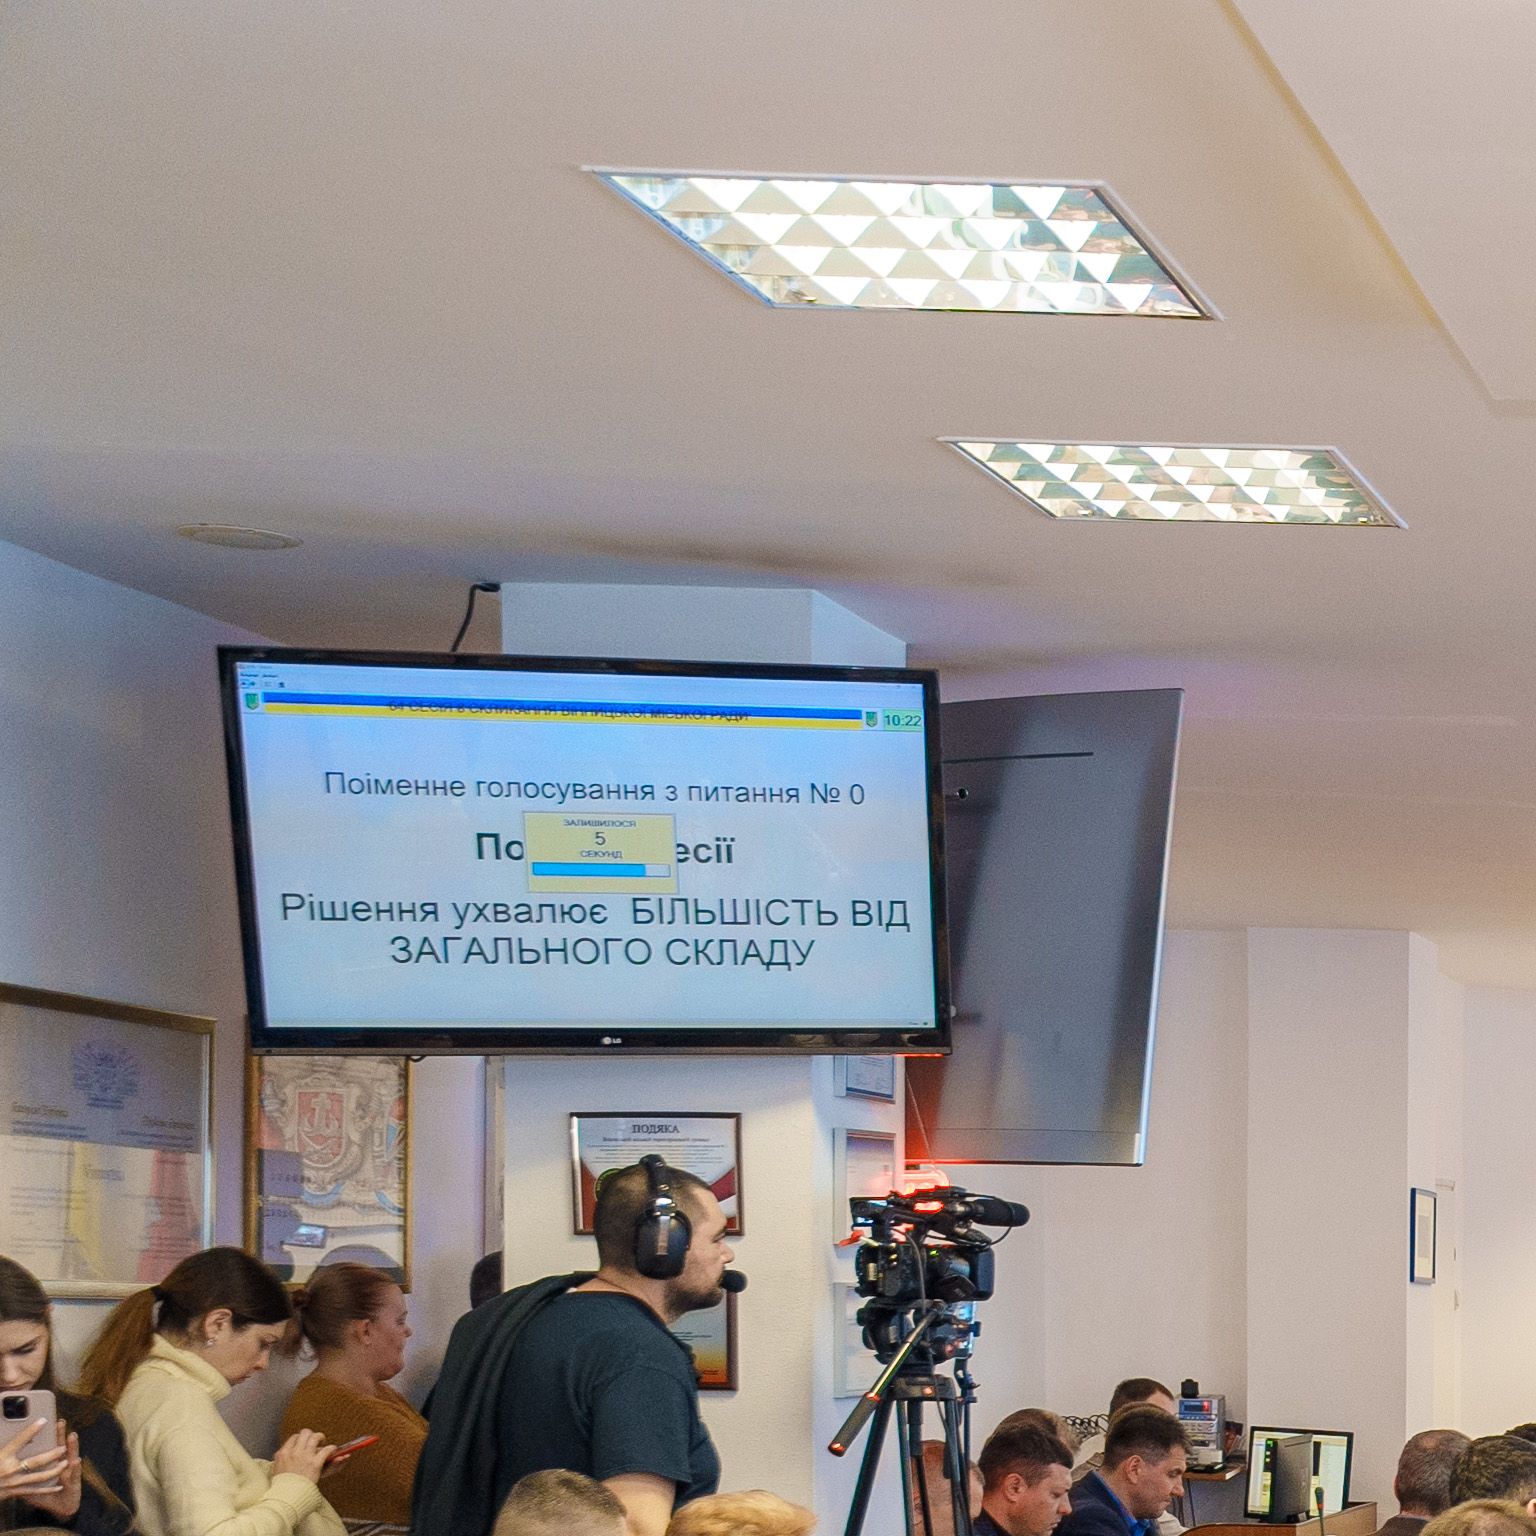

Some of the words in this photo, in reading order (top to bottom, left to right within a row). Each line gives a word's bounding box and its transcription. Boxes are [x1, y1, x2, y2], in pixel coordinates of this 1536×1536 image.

[884, 714, 922, 727] 10:22
[325, 771, 467, 798] Поіменне
[476, 779, 655, 804] голосування
[665, 784, 679, 802] з
[688, 785, 800, 804] питання
[810, 783, 841, 805] №
[849, 783, 865, 805] 0
[563, 818, 637, 828] ЗАЛИШИЛОСЯ
[595, 831, 606, 846] 5
[476, 832, 525, 861] По
[676, 836, 736, 864] есії
[580, 849, 623, 860] СЕКУНД
[281, 893, 439, 923] Рішення
[451, 900, 609, 930] ухвалює
[632, 897, 839, 926] БІЛЬШІСТЬ
[852, 899, 911, 933] ВІД
[390, 935, 652, 966] ЗАГАЛЬНОГО
[665, 938, 815, 971] СКЛАДУ
[631, 1124, 681, 1134] ПОДЯКА
